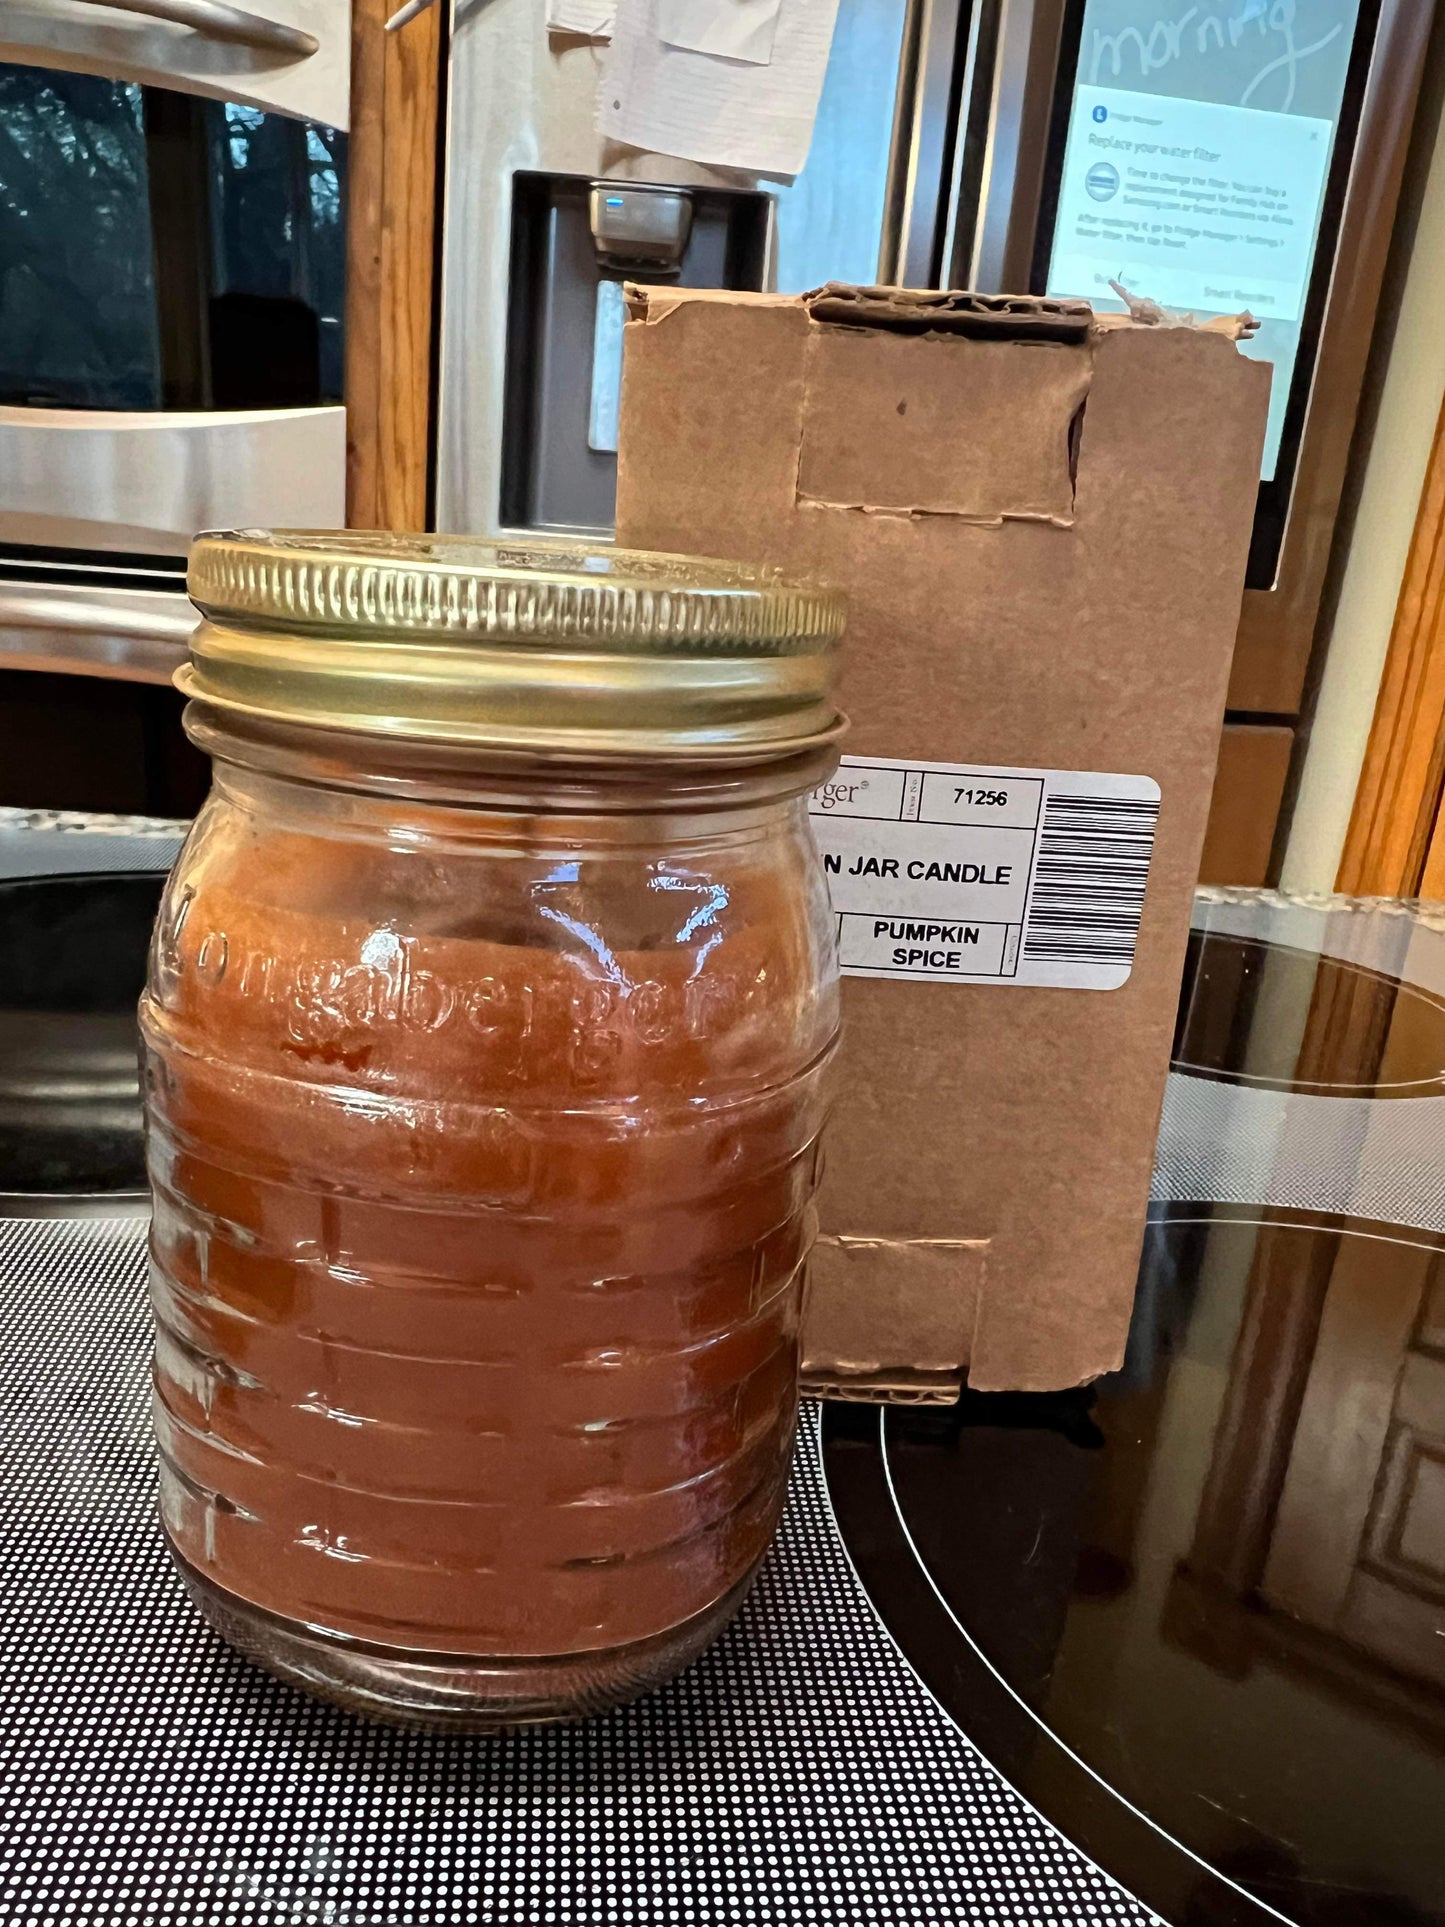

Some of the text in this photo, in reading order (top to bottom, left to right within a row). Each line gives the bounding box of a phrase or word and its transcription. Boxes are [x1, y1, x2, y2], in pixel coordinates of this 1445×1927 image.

[953, 787, 1009, 807] 71256
[822, 853, 1013, 886] N JAR CANDLE
[873, 920, 980, 945] PUMPKIN
[891, 947, 963, 969] SPICE
